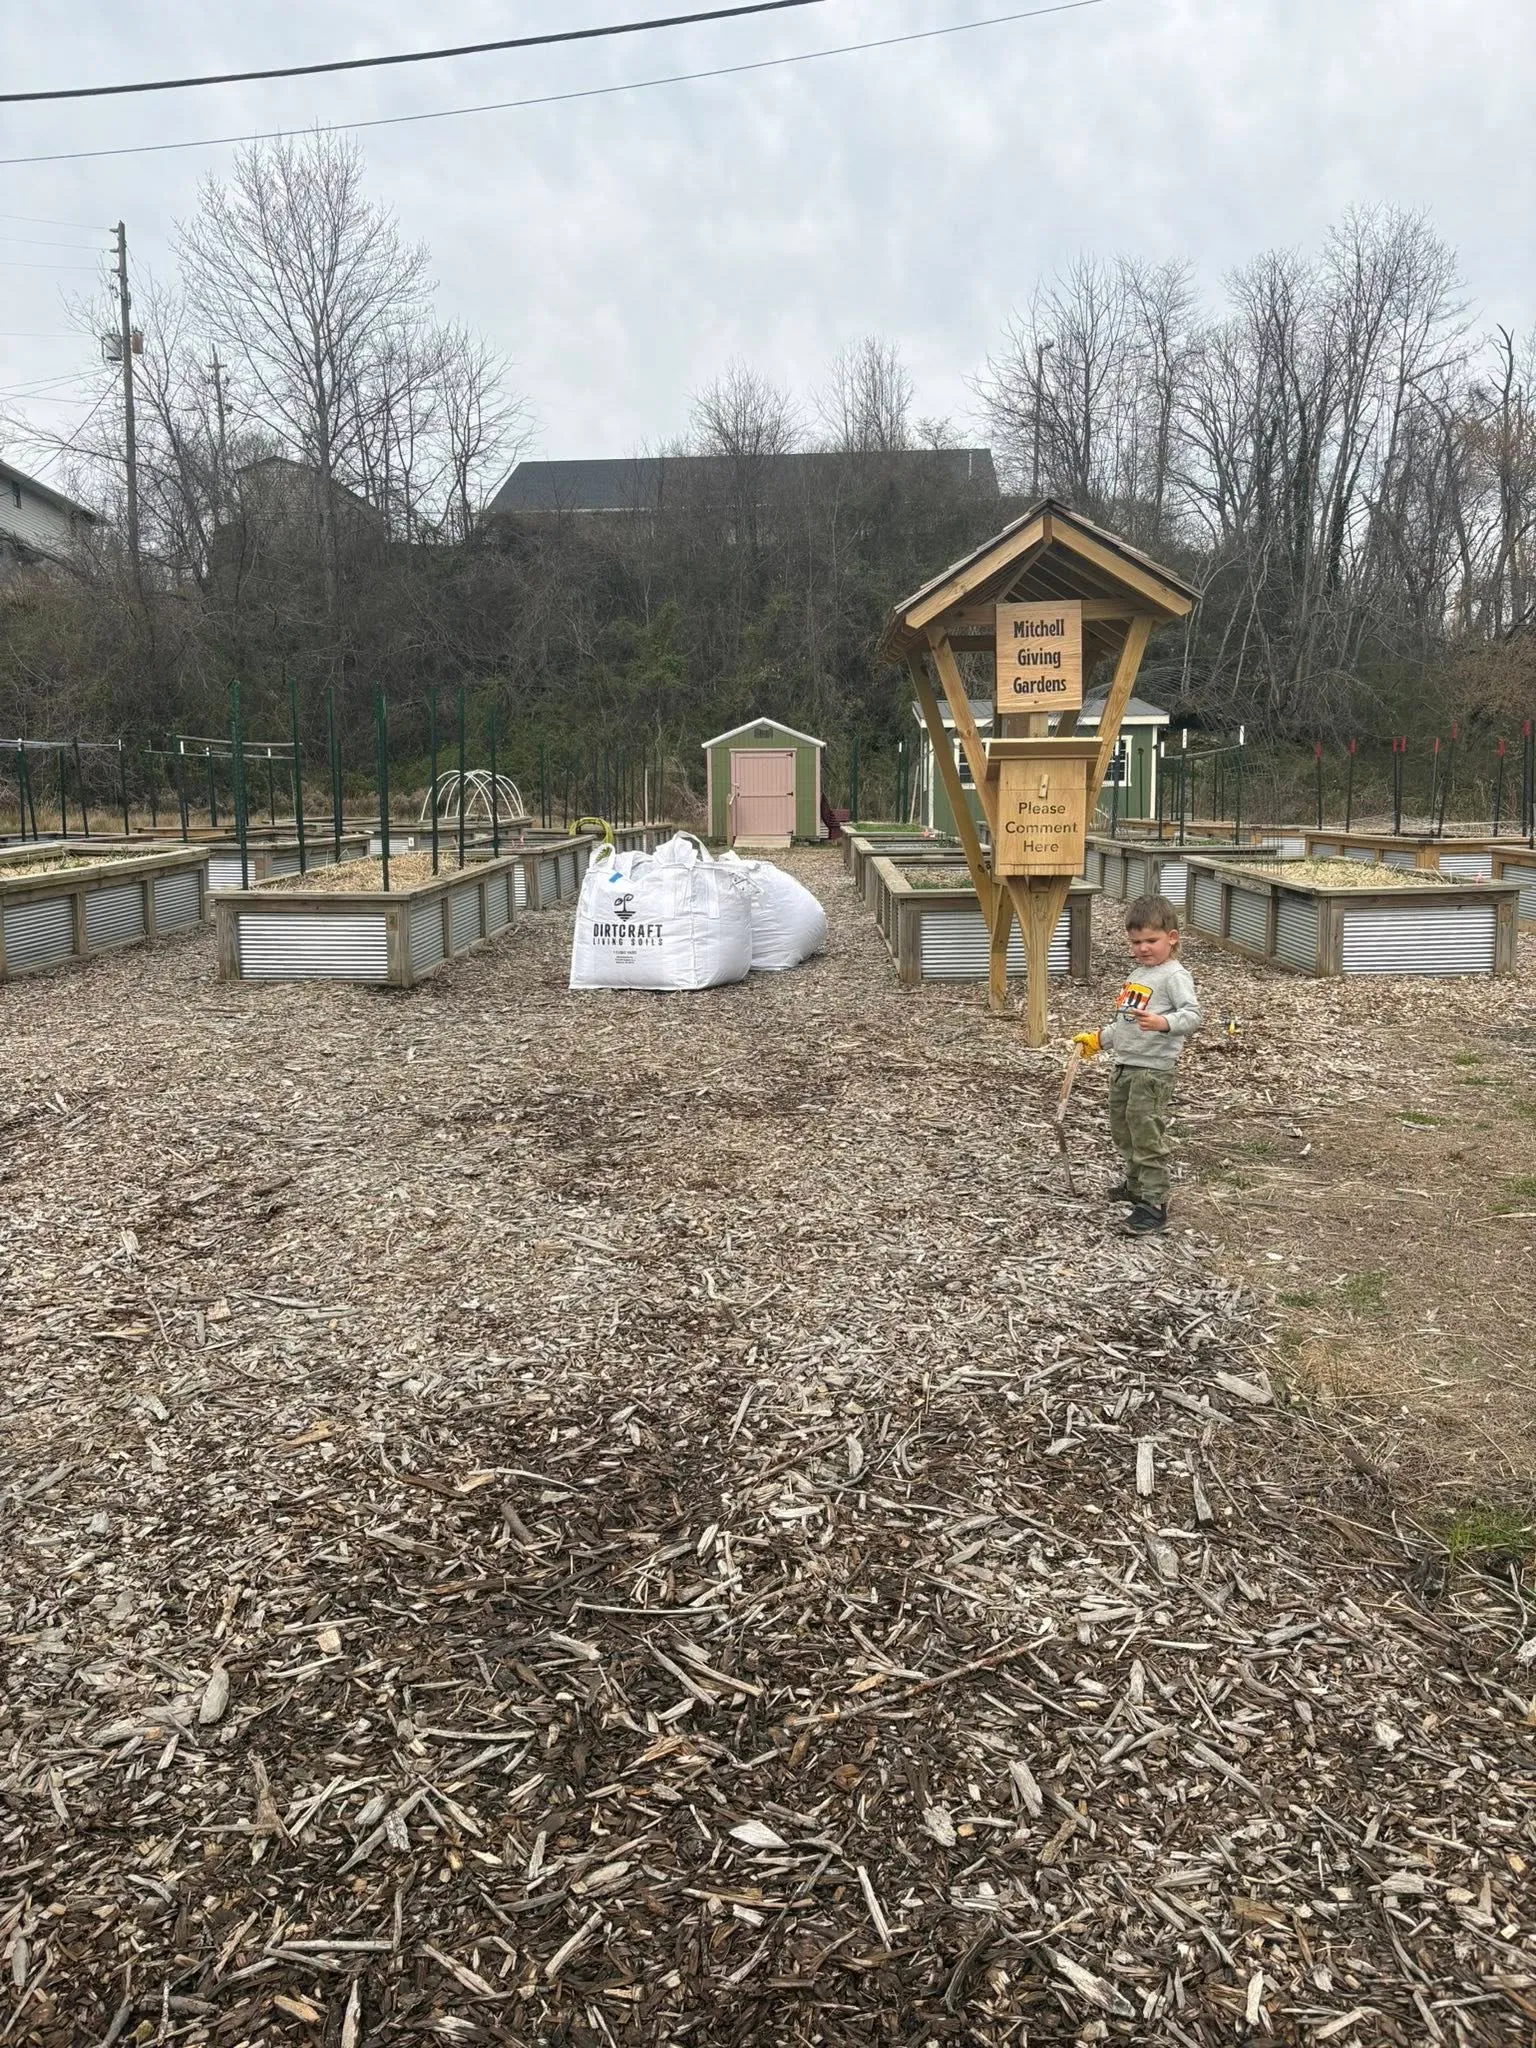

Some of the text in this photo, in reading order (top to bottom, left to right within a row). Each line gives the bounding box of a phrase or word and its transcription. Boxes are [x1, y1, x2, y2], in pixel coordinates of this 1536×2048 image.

[1013, 619, 1065, 638] Mitchell
[1017, 647, 1061, 669] Giving
[1013, 675, 1067, 694] Gardens
[1018, 801, 1066, 815] Please
[1005, 821, 1078, 834] Comment
[1023, 840, 1059, 853] Here
[593, 923, 663, 938] DIRTCRAFT
[592, 938, 663, 946] LIVING SOILS
